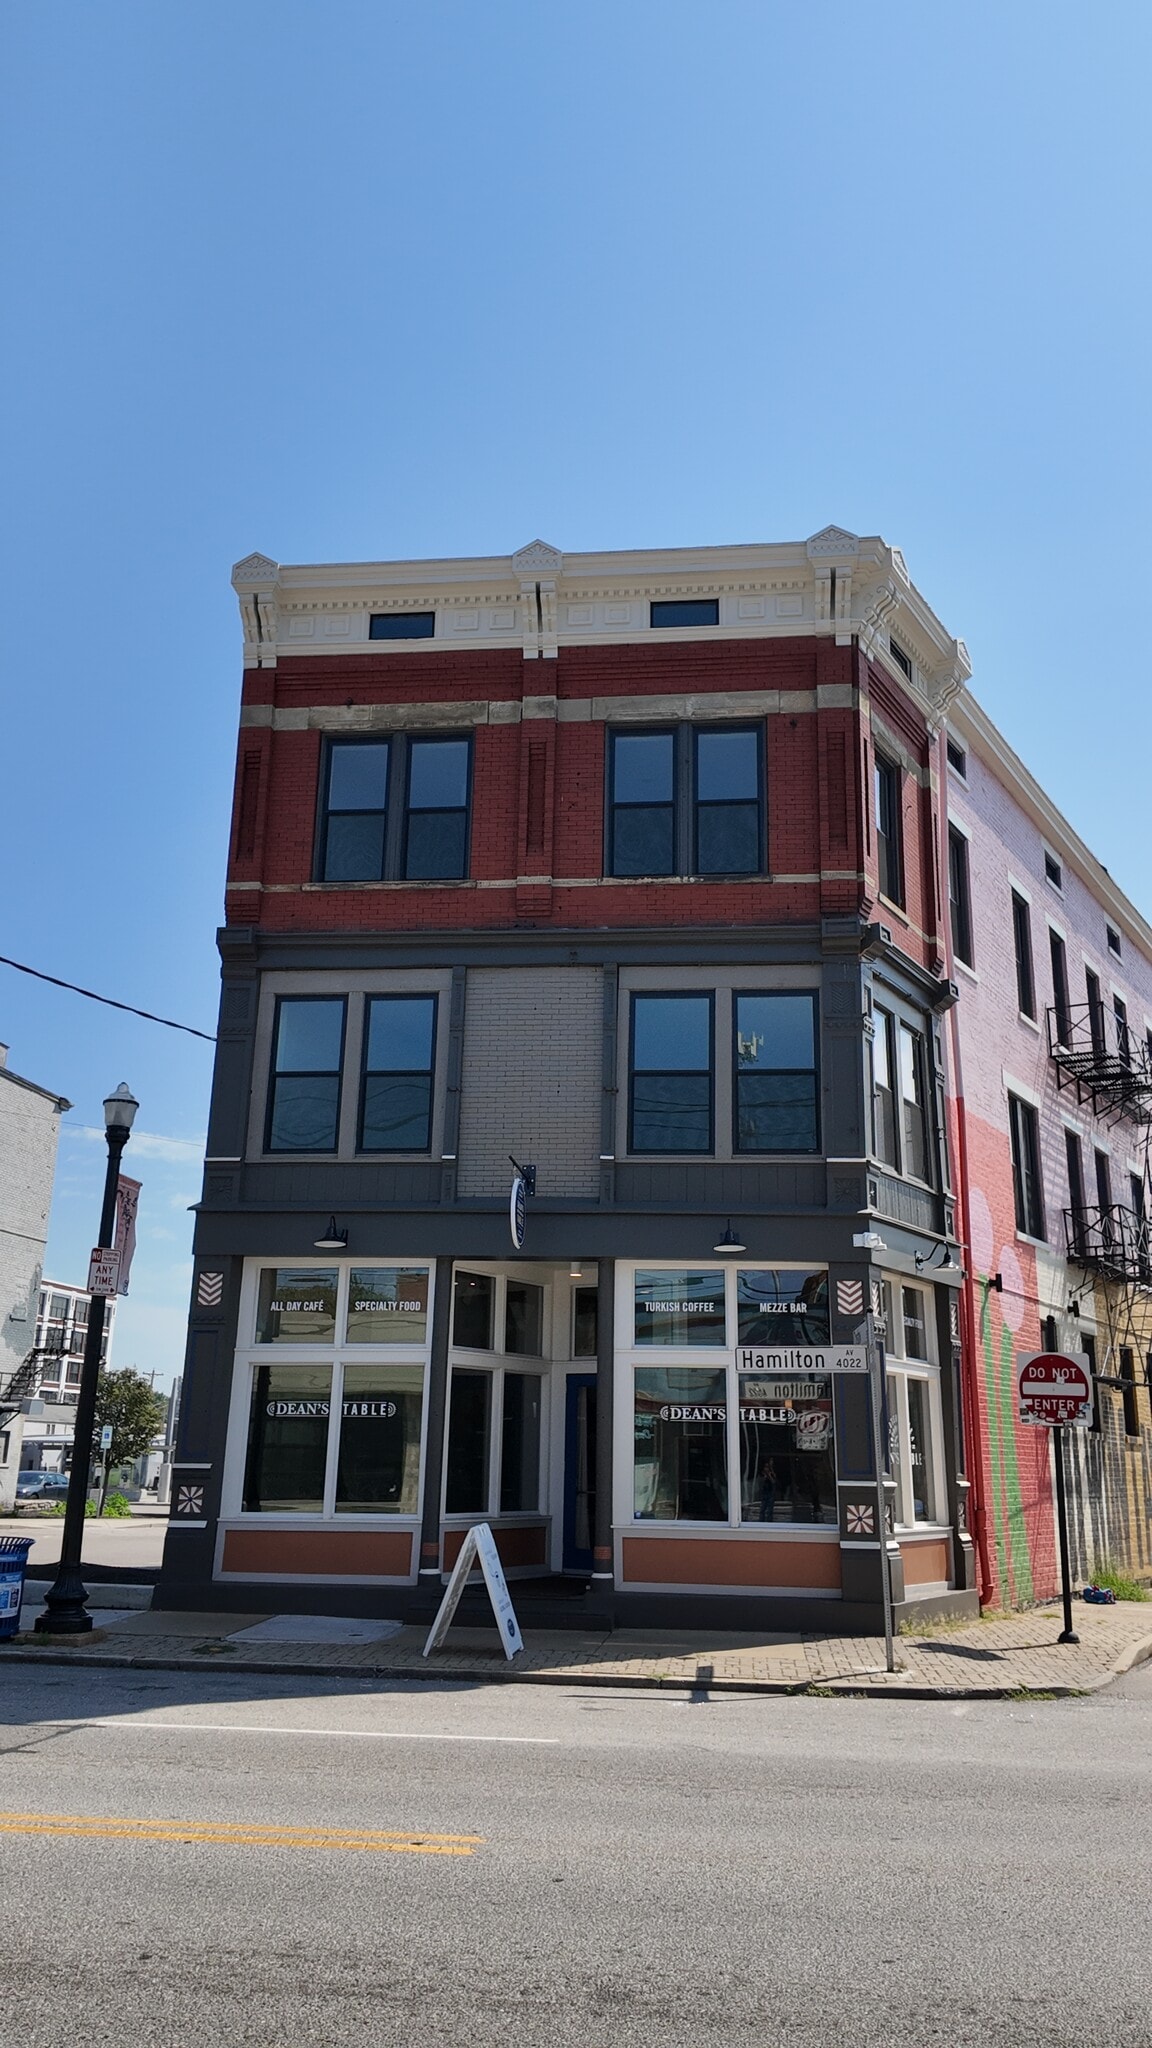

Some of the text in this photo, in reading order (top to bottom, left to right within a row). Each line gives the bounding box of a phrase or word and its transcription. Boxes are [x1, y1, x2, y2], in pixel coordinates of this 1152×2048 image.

[92, 1251, 102, 1261] NO
[96, 1265, 113, 1274] ANY
[94, 1276, 113, 1285] TIME
[270, 1299, 324, 1312] ALL DAY CAFÉ
[354, 1301, 421, 1312] SPECIALTY FOOD
[644, 1301, 715, 1313] TURKISH COFFEE
[759, 1302, 807, 1313] MEZZE BAR
[742, 1350, 862, 1369] Hamilton 4022
[1029, 1367, 1077, 1379] DO NOT
[275, 1403, 387, 1415] DEAN'S TABLE
[1034, 1399, 1075, 1411] ENTER
[669, 1407, 787, 1421] DEAN'S TABLE
